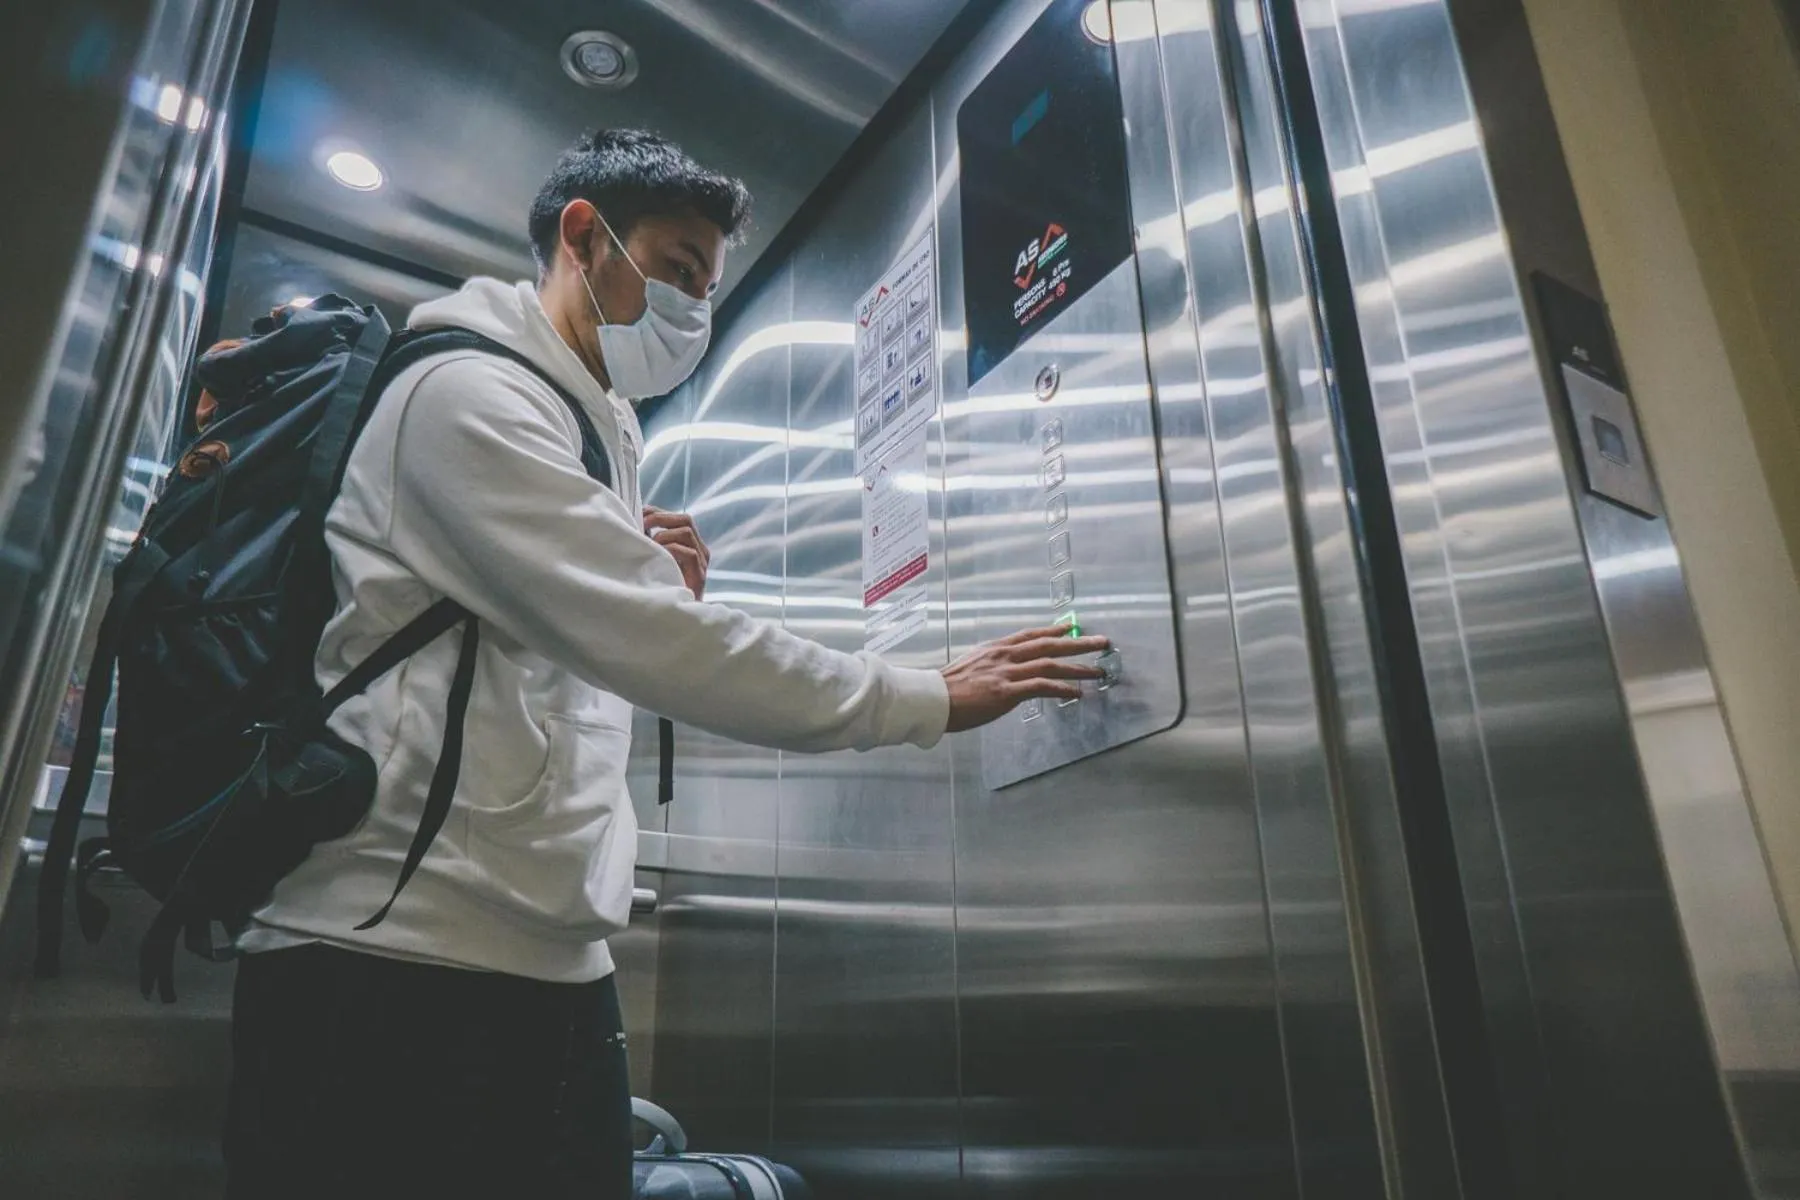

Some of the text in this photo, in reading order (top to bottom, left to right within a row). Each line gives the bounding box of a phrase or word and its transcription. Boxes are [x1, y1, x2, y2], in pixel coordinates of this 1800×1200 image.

[1015, 238, 1040, 275] AS
[1014, 278, 1046, 310] PERSONS
[1014, 287, 1047, 319] CAPACITY
